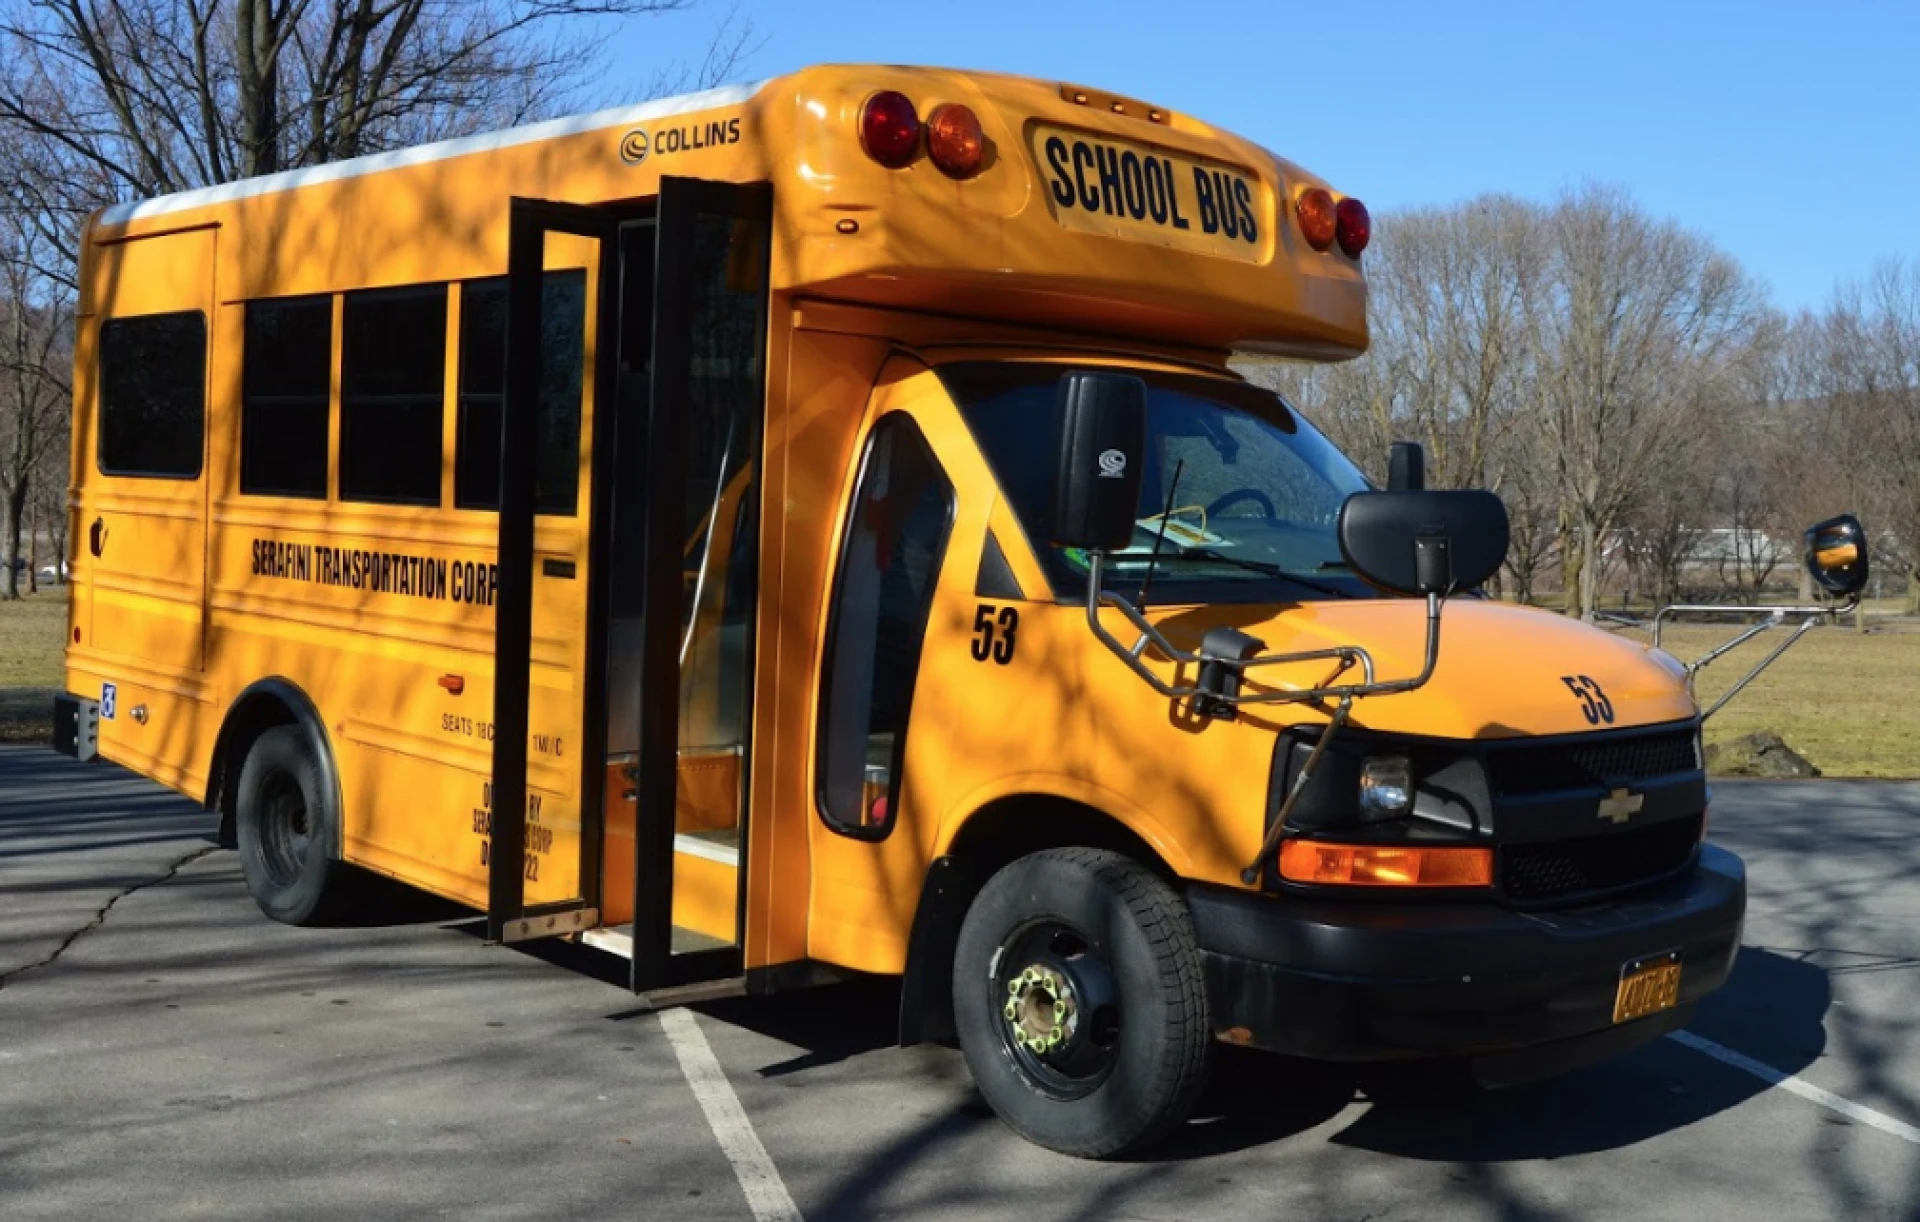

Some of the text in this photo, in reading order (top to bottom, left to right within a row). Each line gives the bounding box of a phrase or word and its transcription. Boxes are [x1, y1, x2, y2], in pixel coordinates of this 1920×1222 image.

[655, 118, 741, 154] COLLINS
[1045, 136, 1258, 243] SCHOOL BUS
[252, 538, 498, 606] SERAFINI TRANSPORTATION CORP
[971, 604, 1019, 666] 53
[441, 713, 473, 736] SEATS
[1560, 675, 1615, 725] 53
